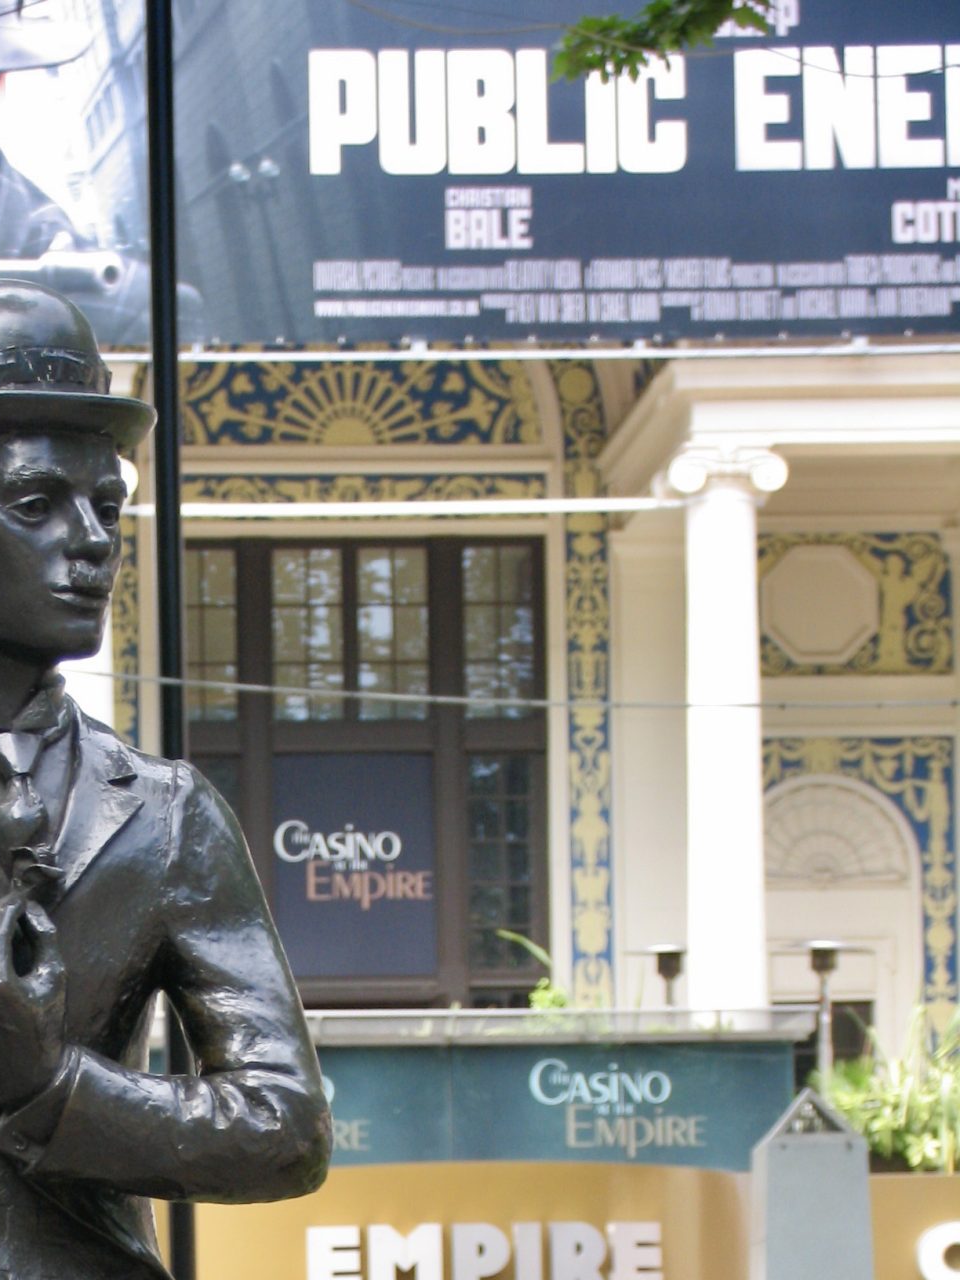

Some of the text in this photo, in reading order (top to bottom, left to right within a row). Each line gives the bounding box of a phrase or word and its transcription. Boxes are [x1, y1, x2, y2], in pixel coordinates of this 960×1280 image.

[308, 44, 960, 175] PUBLIC ENE
[445, 209, 533, 249] BALE
